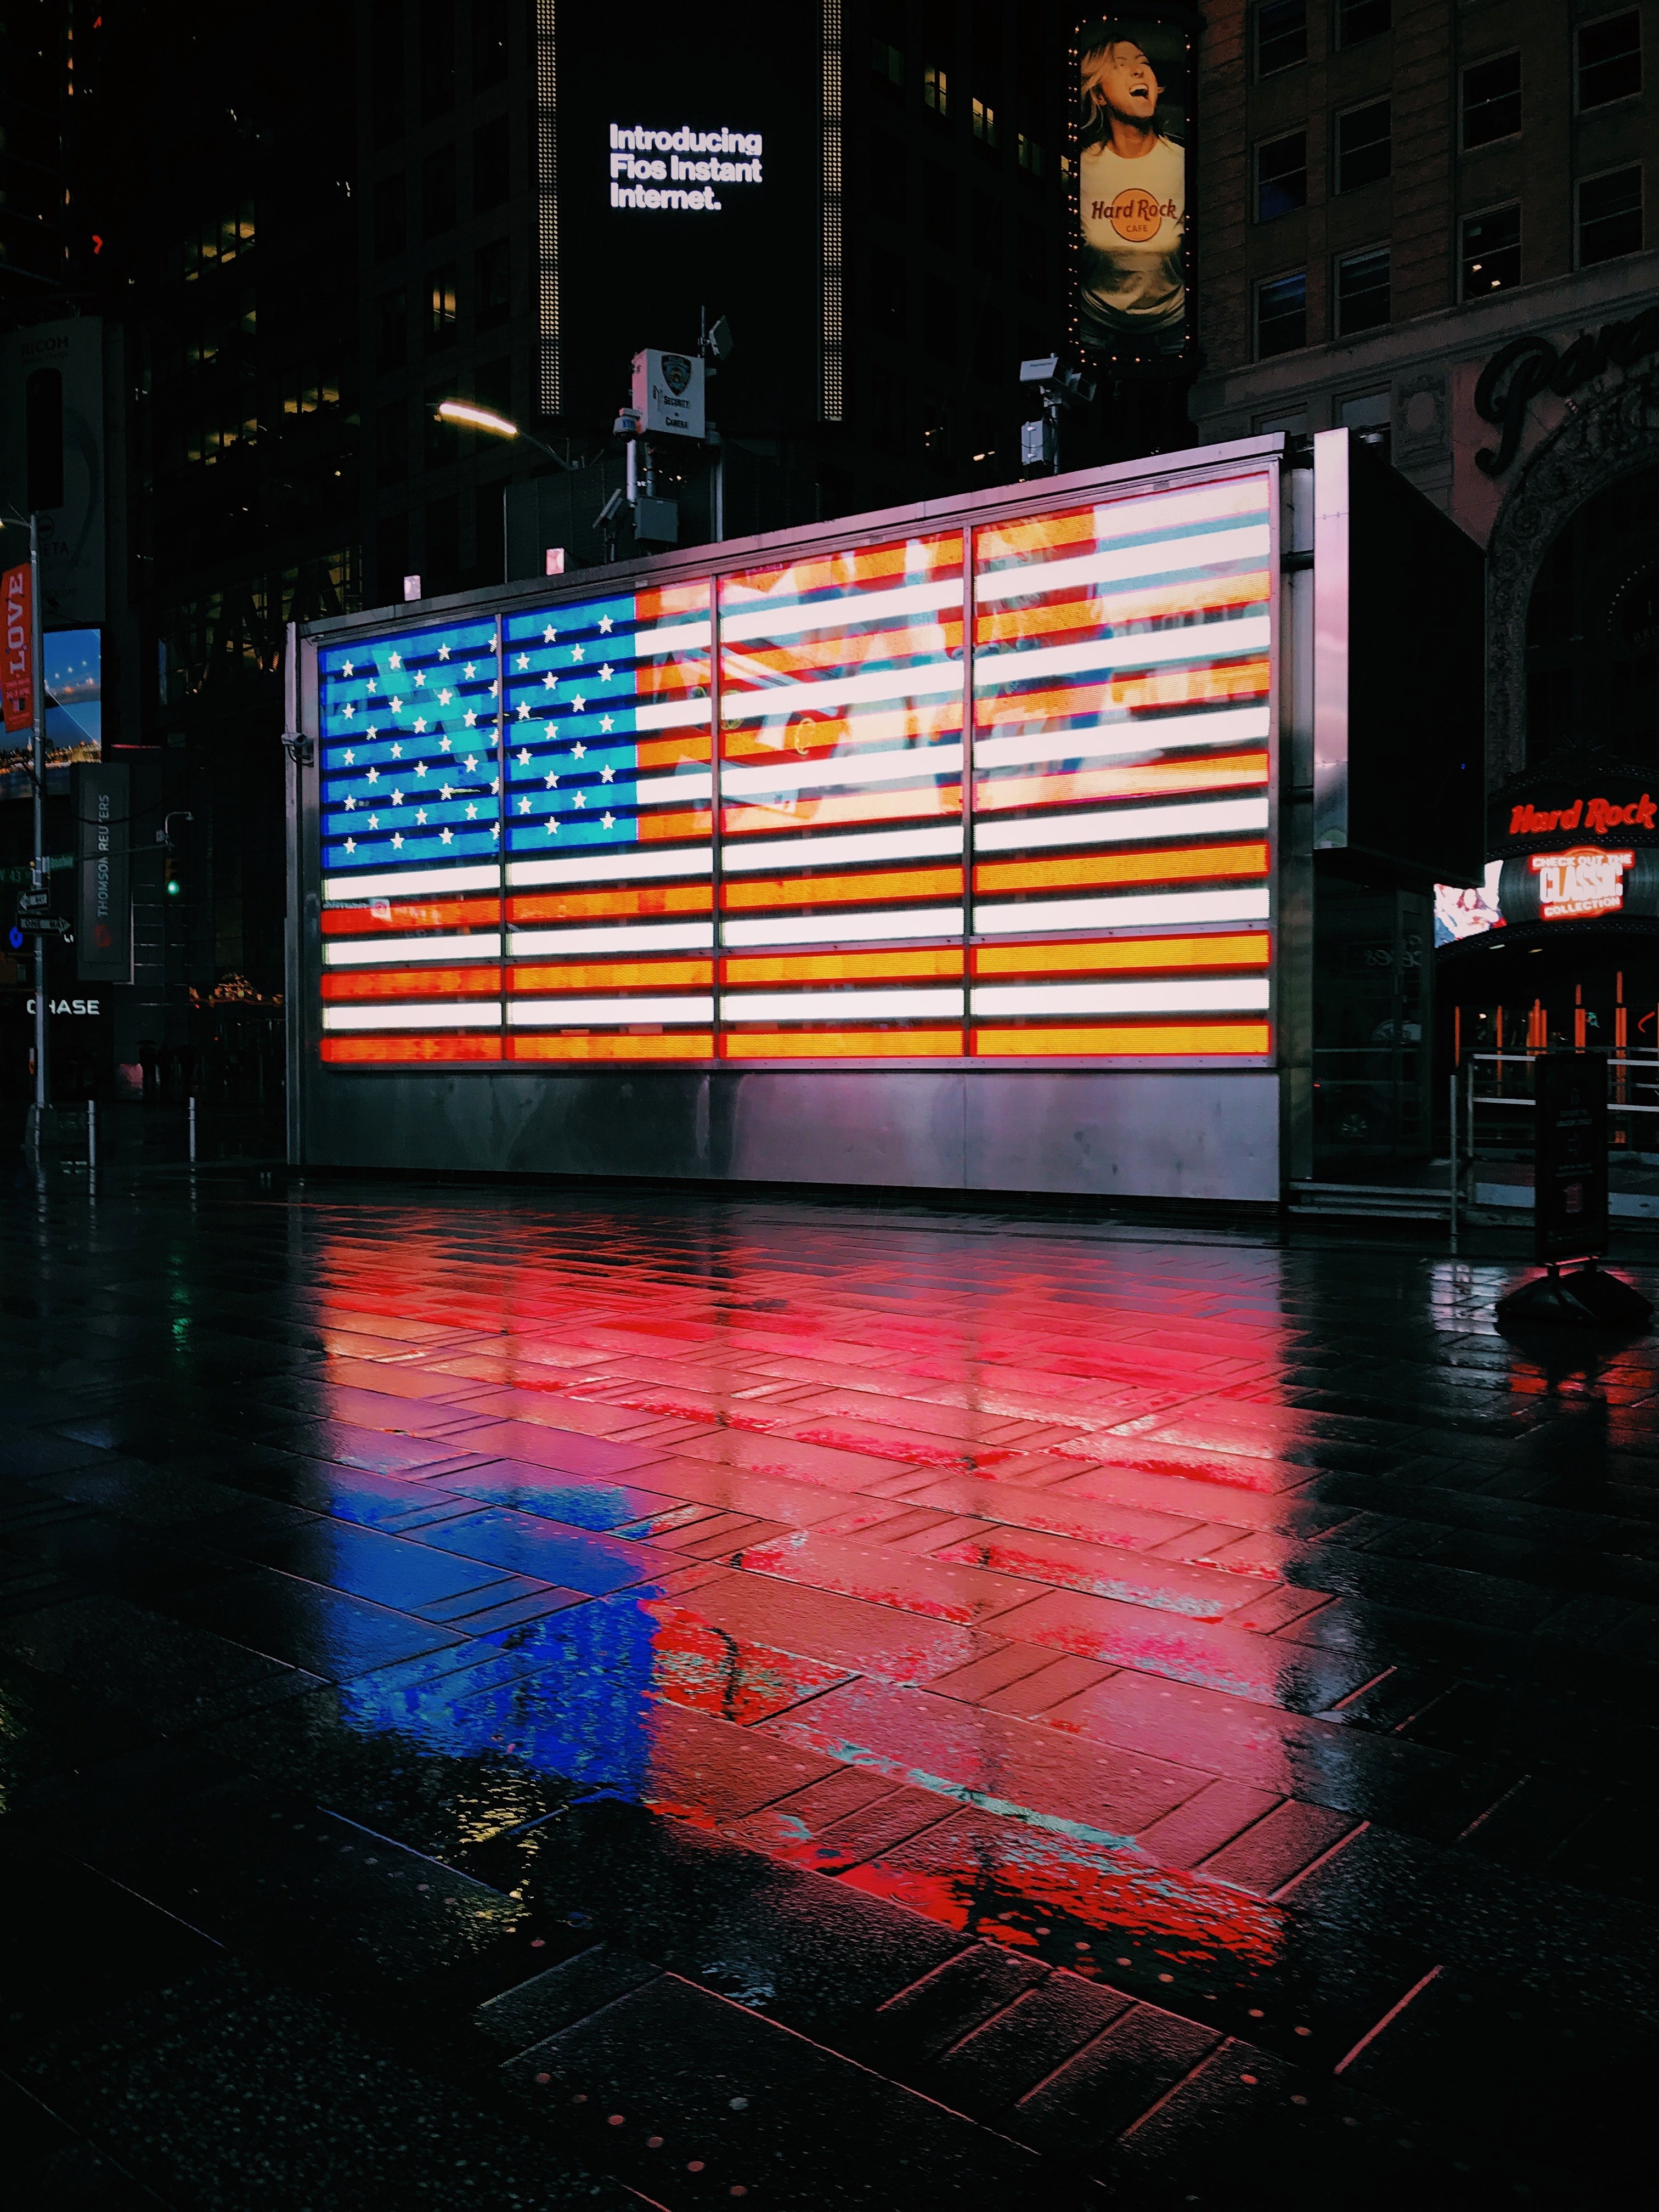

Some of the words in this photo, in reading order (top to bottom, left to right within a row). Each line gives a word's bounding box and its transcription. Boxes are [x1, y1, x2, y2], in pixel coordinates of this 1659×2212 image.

[610, 123, 762, 155] Introducing
[611, 153, 667, 179] Fios
[671, 155, 762, 182] Instant
[611, 182, 721, 210] Internet.
[1092, 199, 1134, 219] Hard
[1137, 199, 1177, 221] Rock
[1126, 224, 1148, 233] CAFE
[21, 335, 69, 357] RICOH
[664, 396, 690, 409] SECURITY
[7, 572, 26, 675] LOVE
[1509, 799, 1583, 834] Hard
[1584, 793, 1657, 834] Rock
[1532, 856, 1576, 867] CHECK
[1578, 855, 1605, 865] OUT
[1540, 864, 1623, 903] CLASSIC
[1544, 897, 1621, 916] COLLECTION
